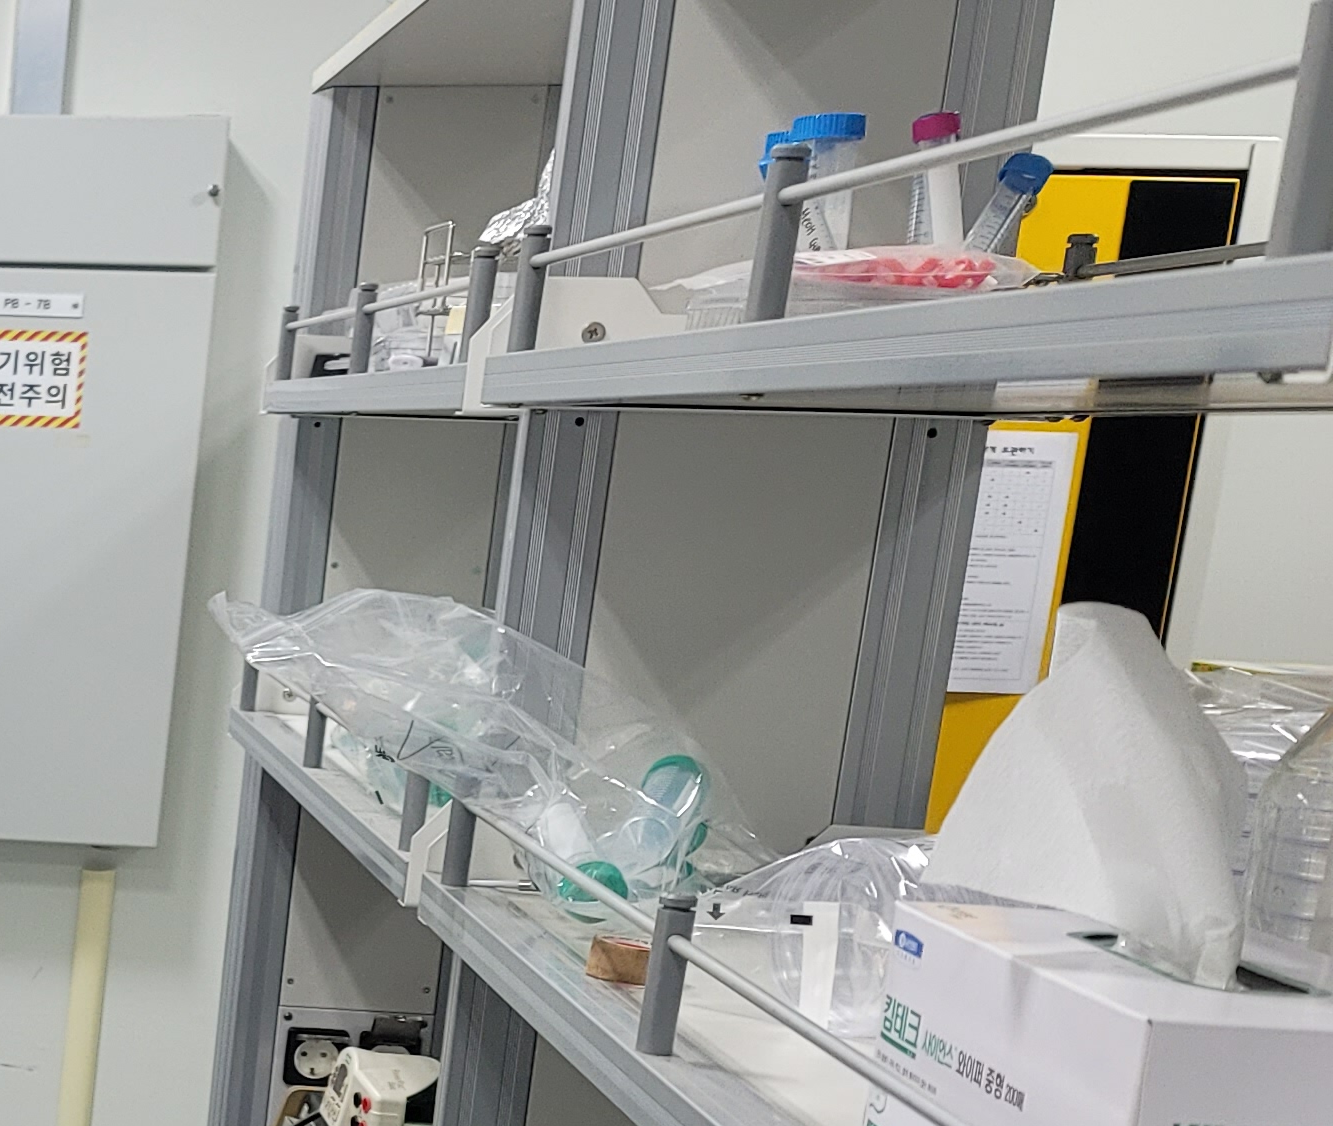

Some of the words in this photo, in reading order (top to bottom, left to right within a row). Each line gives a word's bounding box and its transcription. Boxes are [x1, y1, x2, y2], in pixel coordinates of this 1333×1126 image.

[883, 994, 922, 1049] 킴테크
[921, 1029, 955, 1069] 사이언스
[955, 1049, 984, 1088] 와이퍼
[985, 1066, 1006, 1100] 중형
